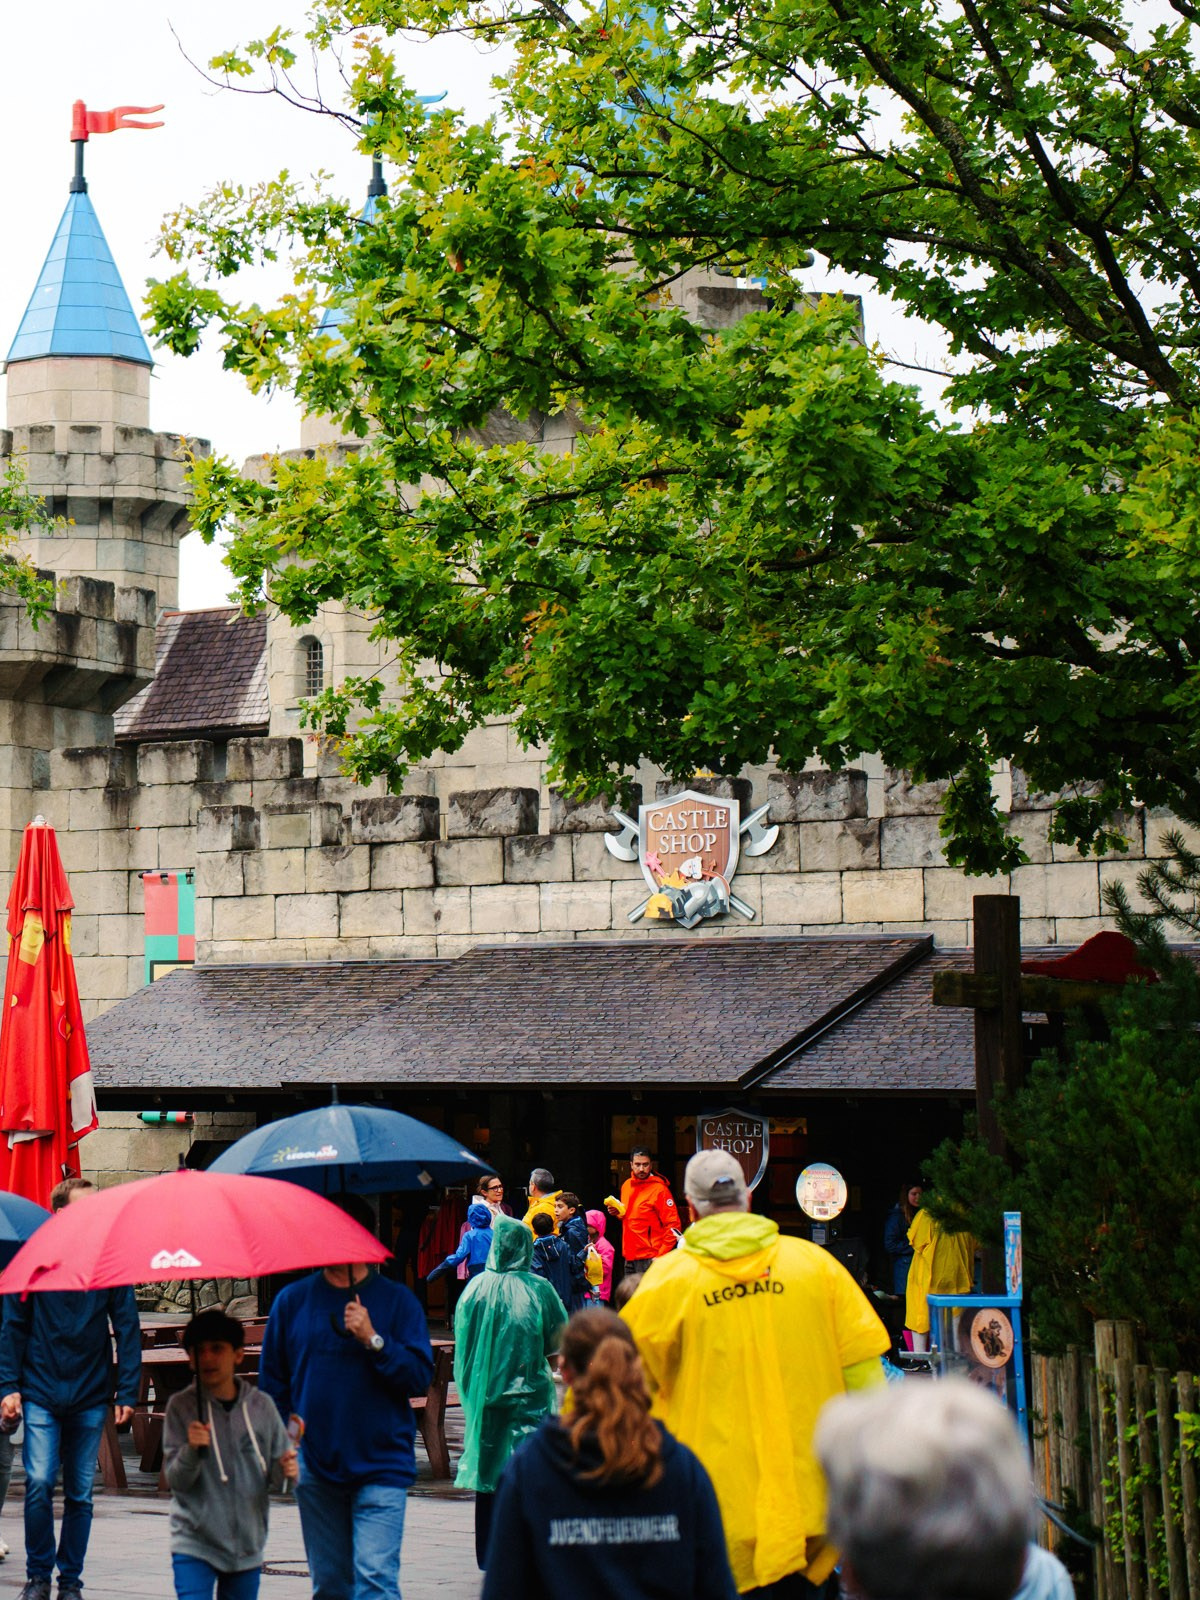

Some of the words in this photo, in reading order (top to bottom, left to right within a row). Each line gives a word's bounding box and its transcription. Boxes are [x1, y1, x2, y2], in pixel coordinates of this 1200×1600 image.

[648, 808, 728, 832] CASTLE
[659, 833, 717, 854] SHOP
[704, 1121, 762, 1138] CASTLE
[712, 1138, 754, 1154] SHOP
[549, 1515, 680, 1545] JUGENDFEUERWEHR
